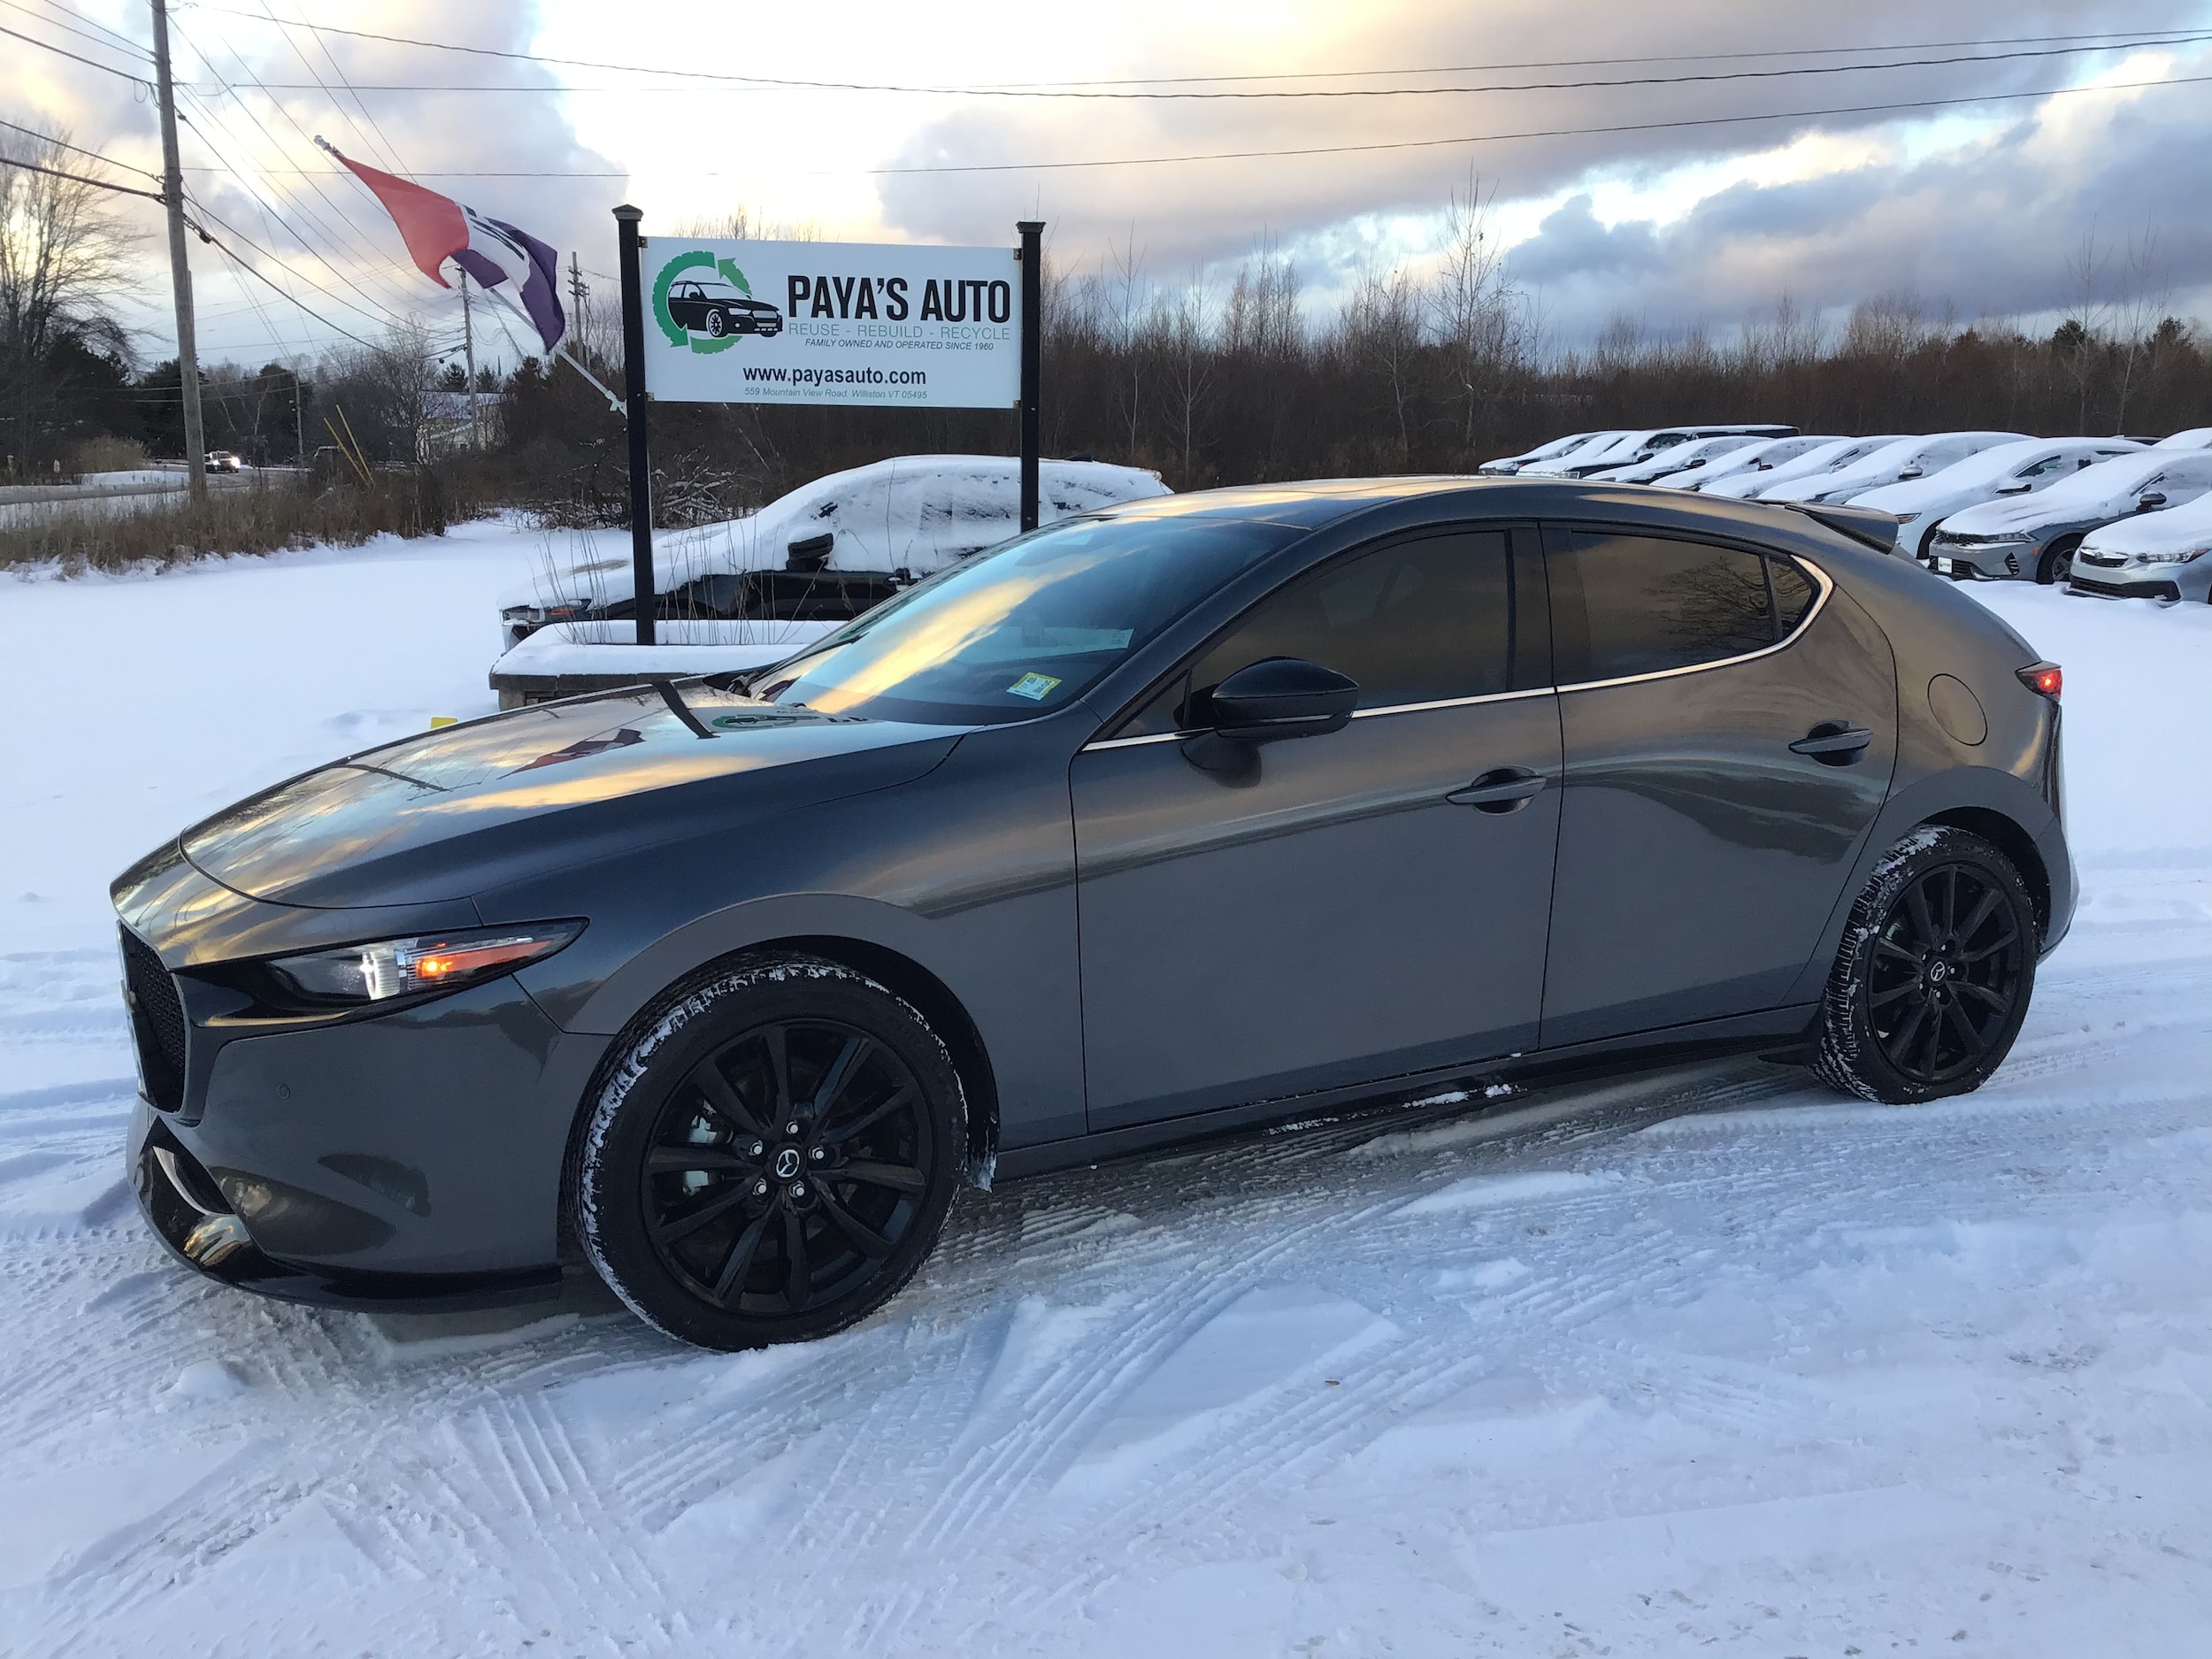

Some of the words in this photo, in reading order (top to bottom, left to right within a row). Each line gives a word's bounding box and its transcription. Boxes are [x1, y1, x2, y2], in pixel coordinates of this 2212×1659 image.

[787, 274, 909, 321] PAYA'S
[920, 280, 1010, 323] AUTO
[788, 322, 840, 336] REUSE
[857, 324, 923, 339] REBUILD
[941, 326, 1010, 341] RECYCLE
[804, 338, 837, 348] FAMILY
[838, 340, 872, 349] OWNED
[873, 340, 894, 349] AND
[895, 340, 943, 350] OPERATED
[944, 341, 972, 351] SINCE
[974, 342, 995, 351] 1960
[743, 366, 926, 387] www.payasauto.com
[744, 387, 760, 396] 559
[762, 388, 801, 397] Mountain
[803, 388, 823, 397] View
[851, 389, 886, 399] Williston
[887, 389, 900, 399] VT
[902, 390, 927, 399] 05495
